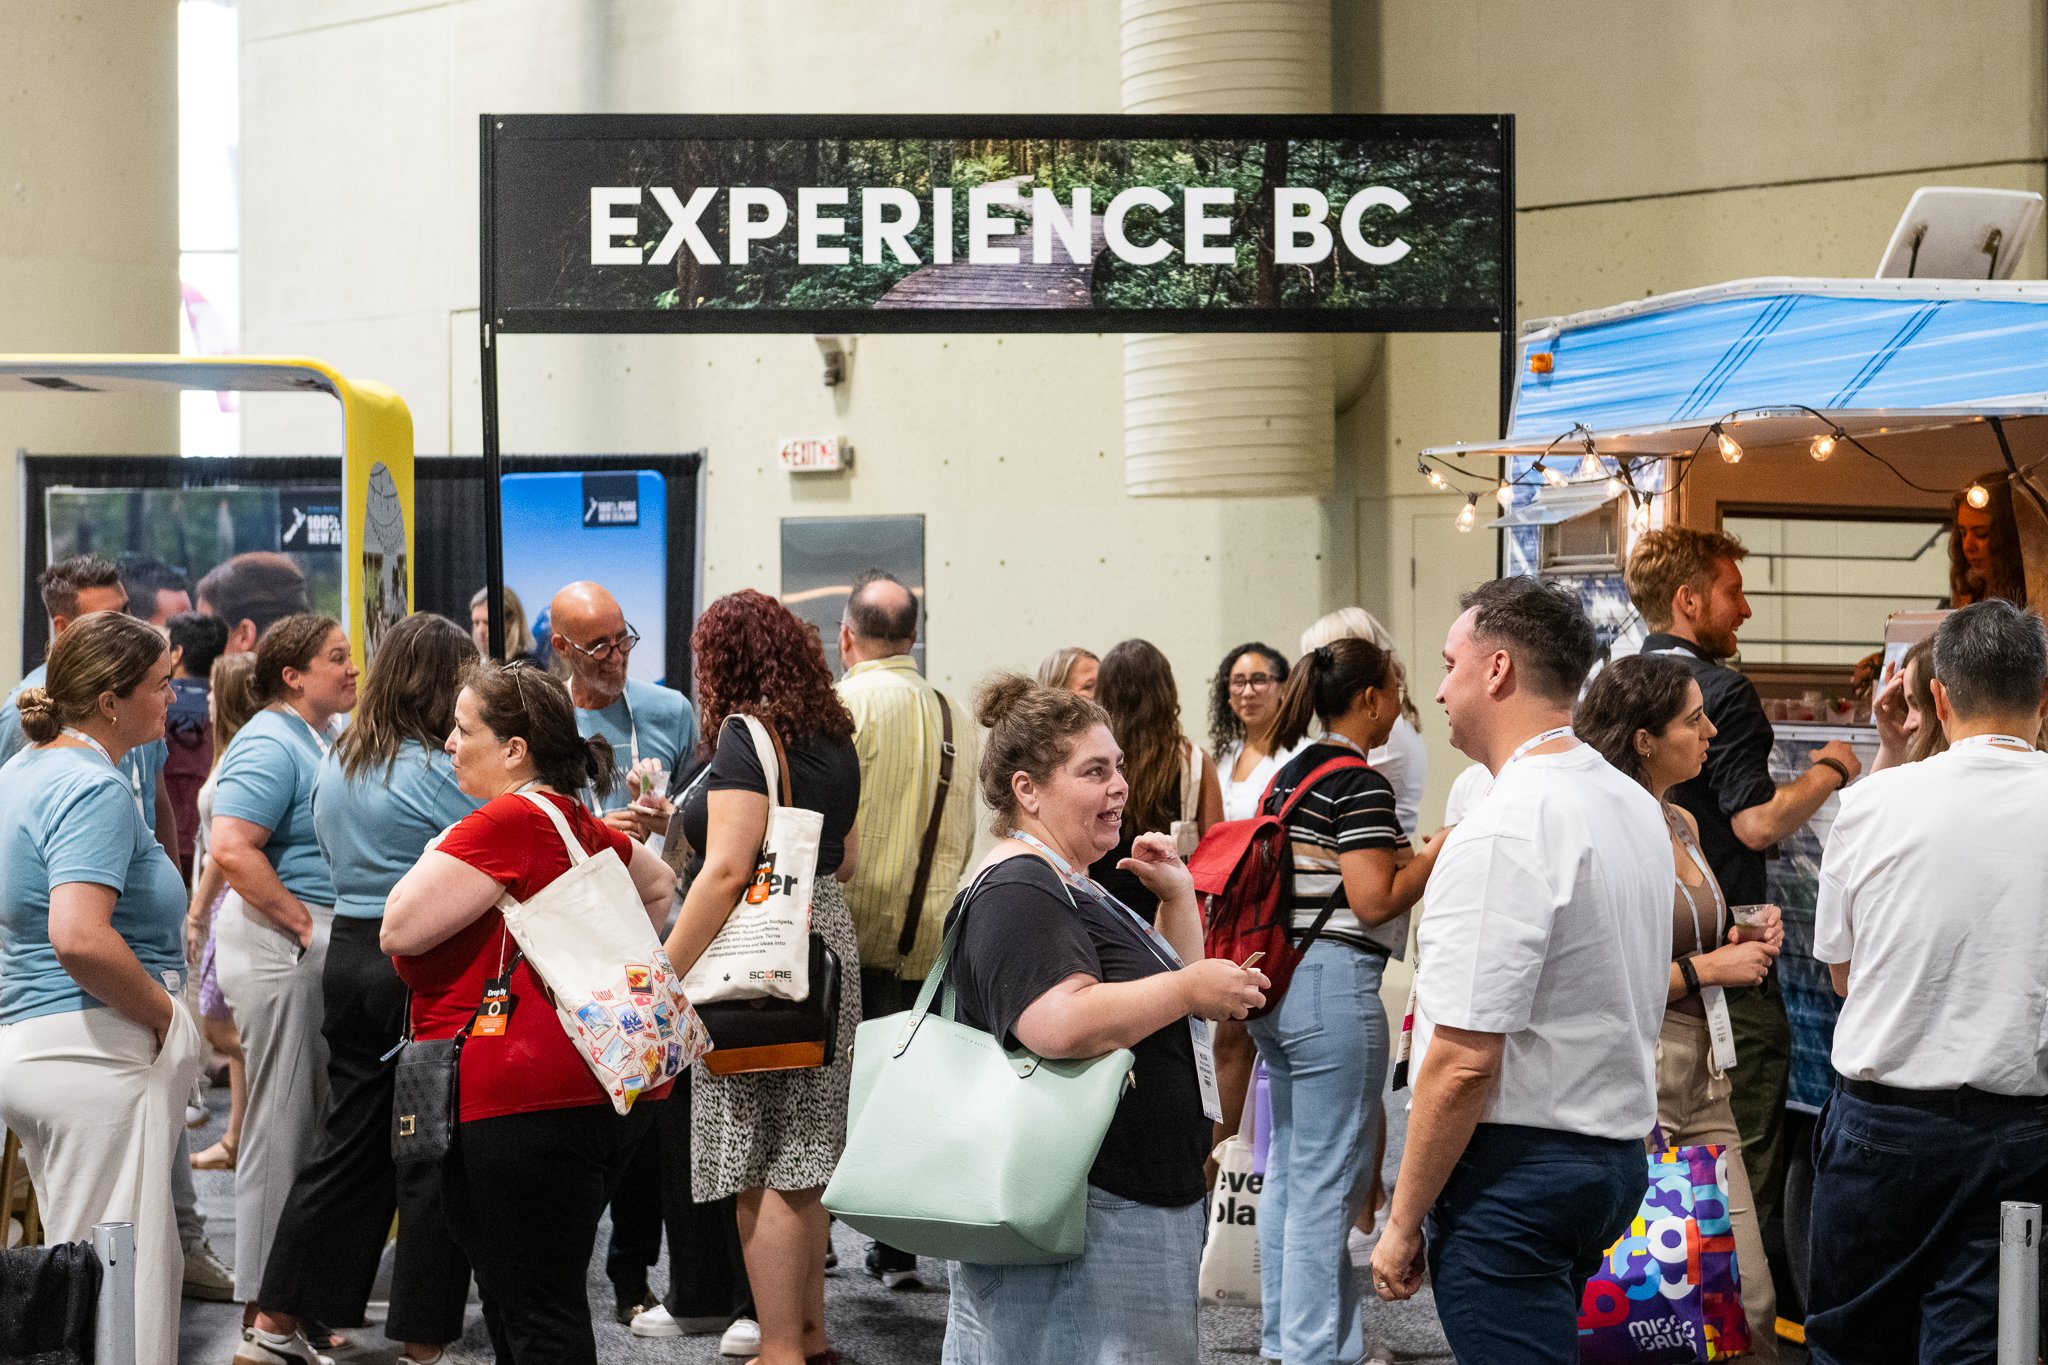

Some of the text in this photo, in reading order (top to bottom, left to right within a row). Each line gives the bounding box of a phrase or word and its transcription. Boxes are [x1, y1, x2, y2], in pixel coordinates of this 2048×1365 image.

[590, 185, 1412, 266] EXPERIENCE BC
[793, 441, 820, 466] EXIT
[617, 500, 637, 512] PURE
[307, 514, 340, 531] 100%
[308, 530, 330, 545] NEW
[749, 969, 792, 980] SCORE
